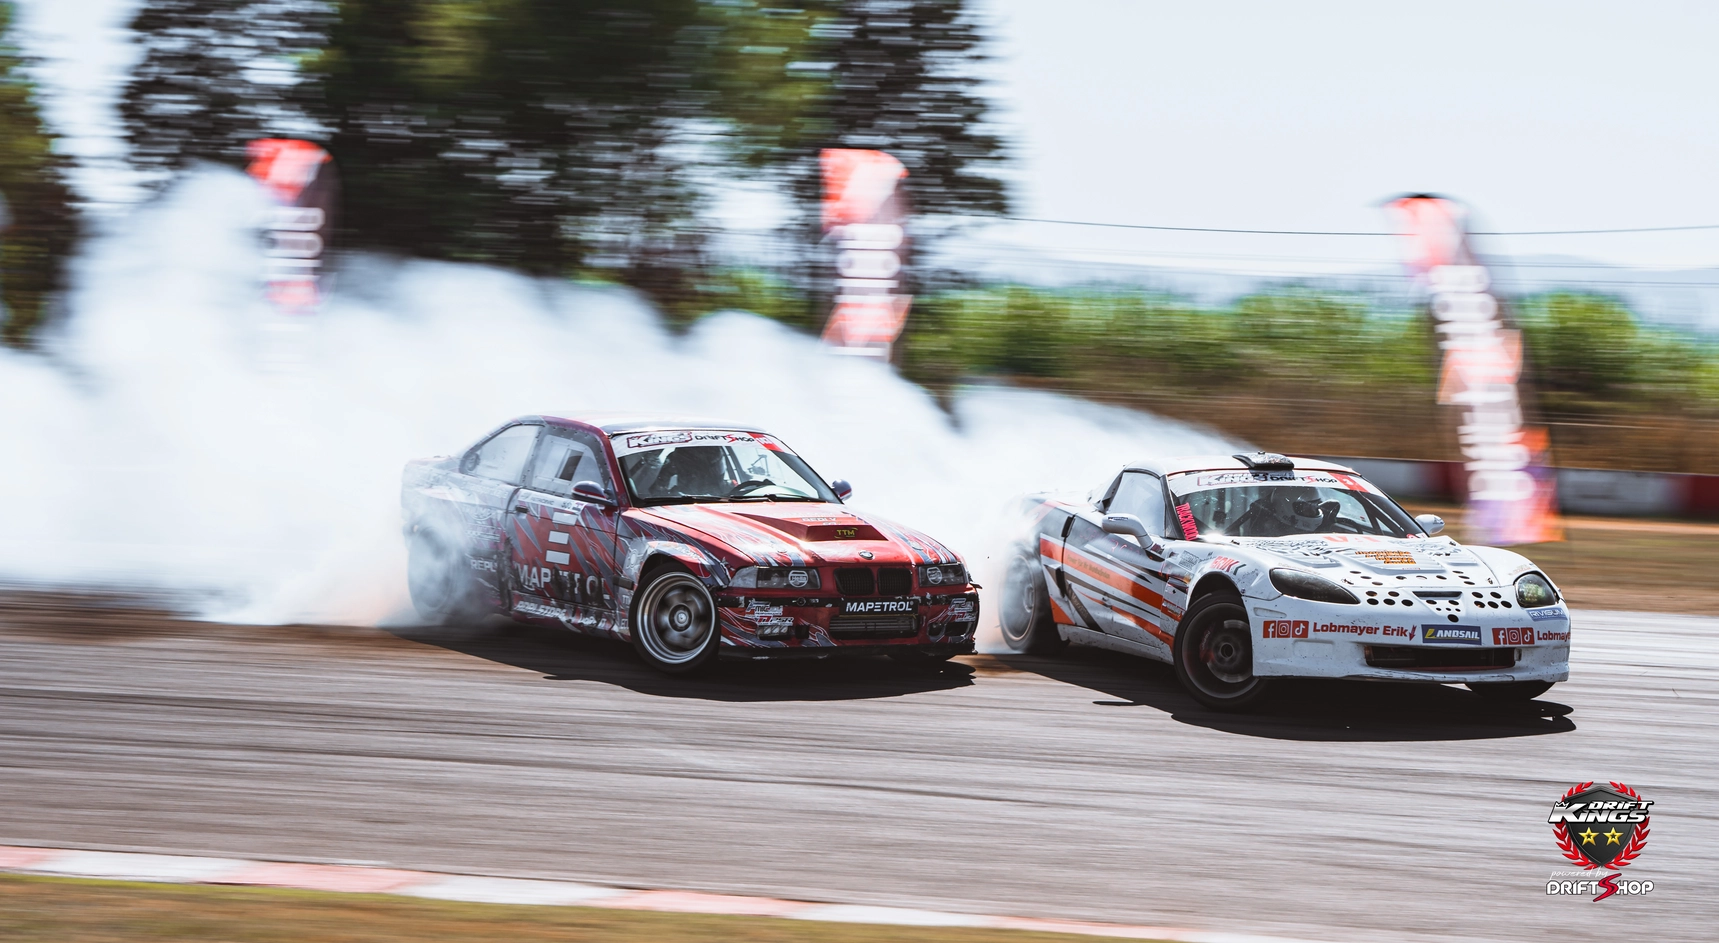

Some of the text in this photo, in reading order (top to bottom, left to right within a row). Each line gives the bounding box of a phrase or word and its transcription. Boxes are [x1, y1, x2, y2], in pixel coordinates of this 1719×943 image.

[845, 601, 913, 612] MAPETROL
[1313, 622, 1408, 637] Lobmayer Erik
[1424, 628, 1480, 640] LANDSAIL
